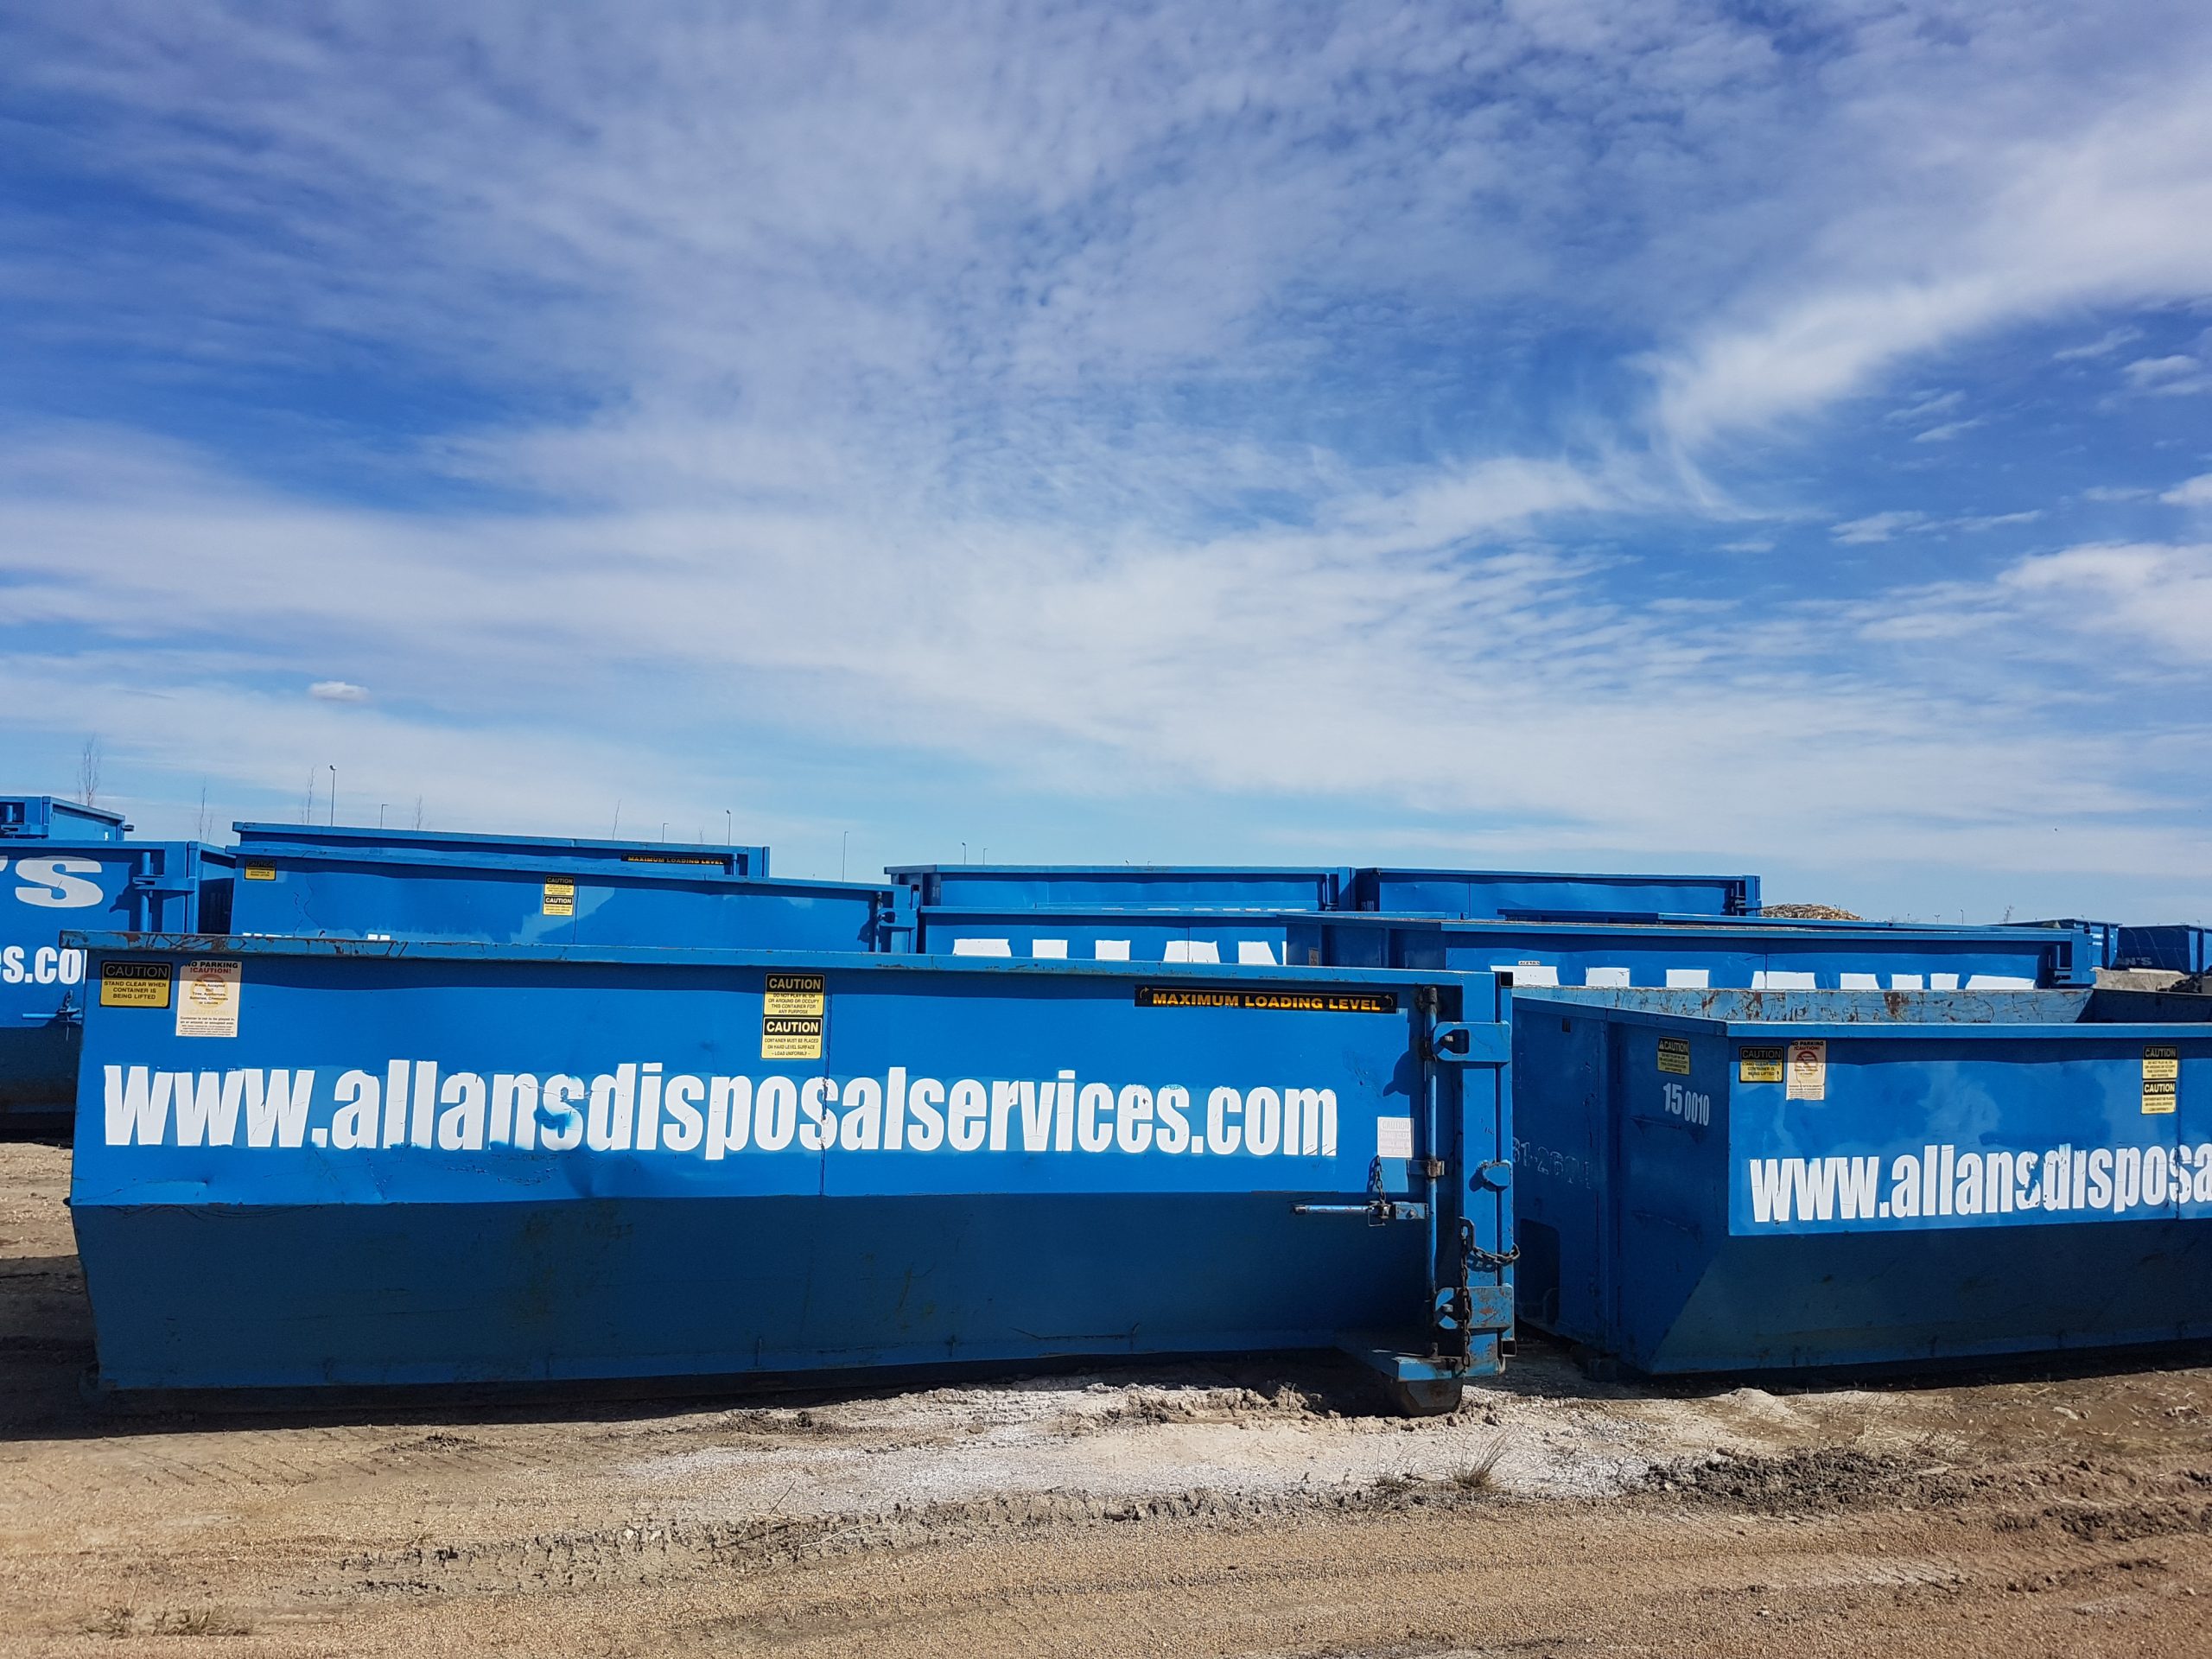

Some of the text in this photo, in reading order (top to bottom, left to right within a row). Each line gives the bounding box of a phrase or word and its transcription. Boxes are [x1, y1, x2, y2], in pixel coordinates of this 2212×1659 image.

[0, 945, 87, 985] s.co
[105, 965, 168, 978] CAUTION
[769, 978, 821, 990] CAUTION
[1153, 993, 1381, 1011] MAXIMUM LOADING LEVEL
[766, 1021, 818, 1033] CAUTION
[1664, 1040, 1688, 1052] CAUTION
[1742, 1050, 1781, 1058] CAUTION
[2145, 1047, 2176, 1058] CAUTION
[2144, 1084, 2175, 1092] CAUTION
[104, 1059, 1338, 1161] www.allansdisposalservices.com
[1663, 1083, 1710, 1126] 15 0010
